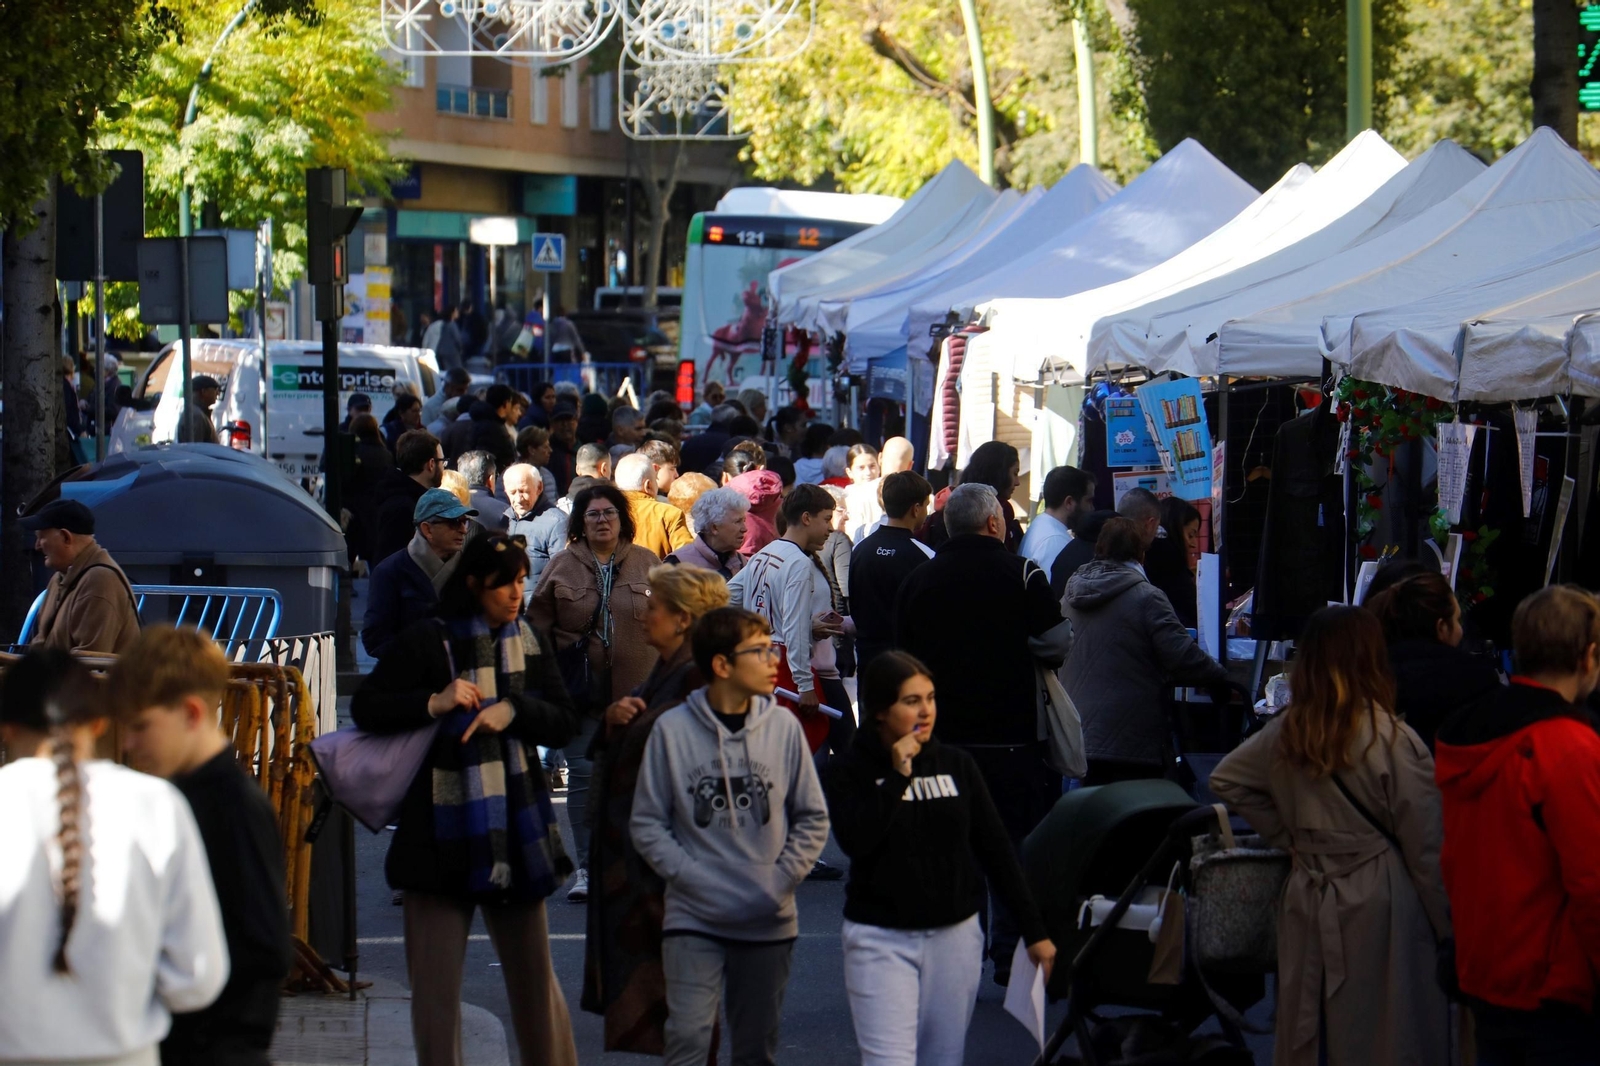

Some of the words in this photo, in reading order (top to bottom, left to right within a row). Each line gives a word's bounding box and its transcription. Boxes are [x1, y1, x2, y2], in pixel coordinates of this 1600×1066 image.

[737, 231, 764, 245] 121
[798, 228, 819, 246] 12
[279, 371, 395, 389] entprise
[301, 465, 319, 475] MND
